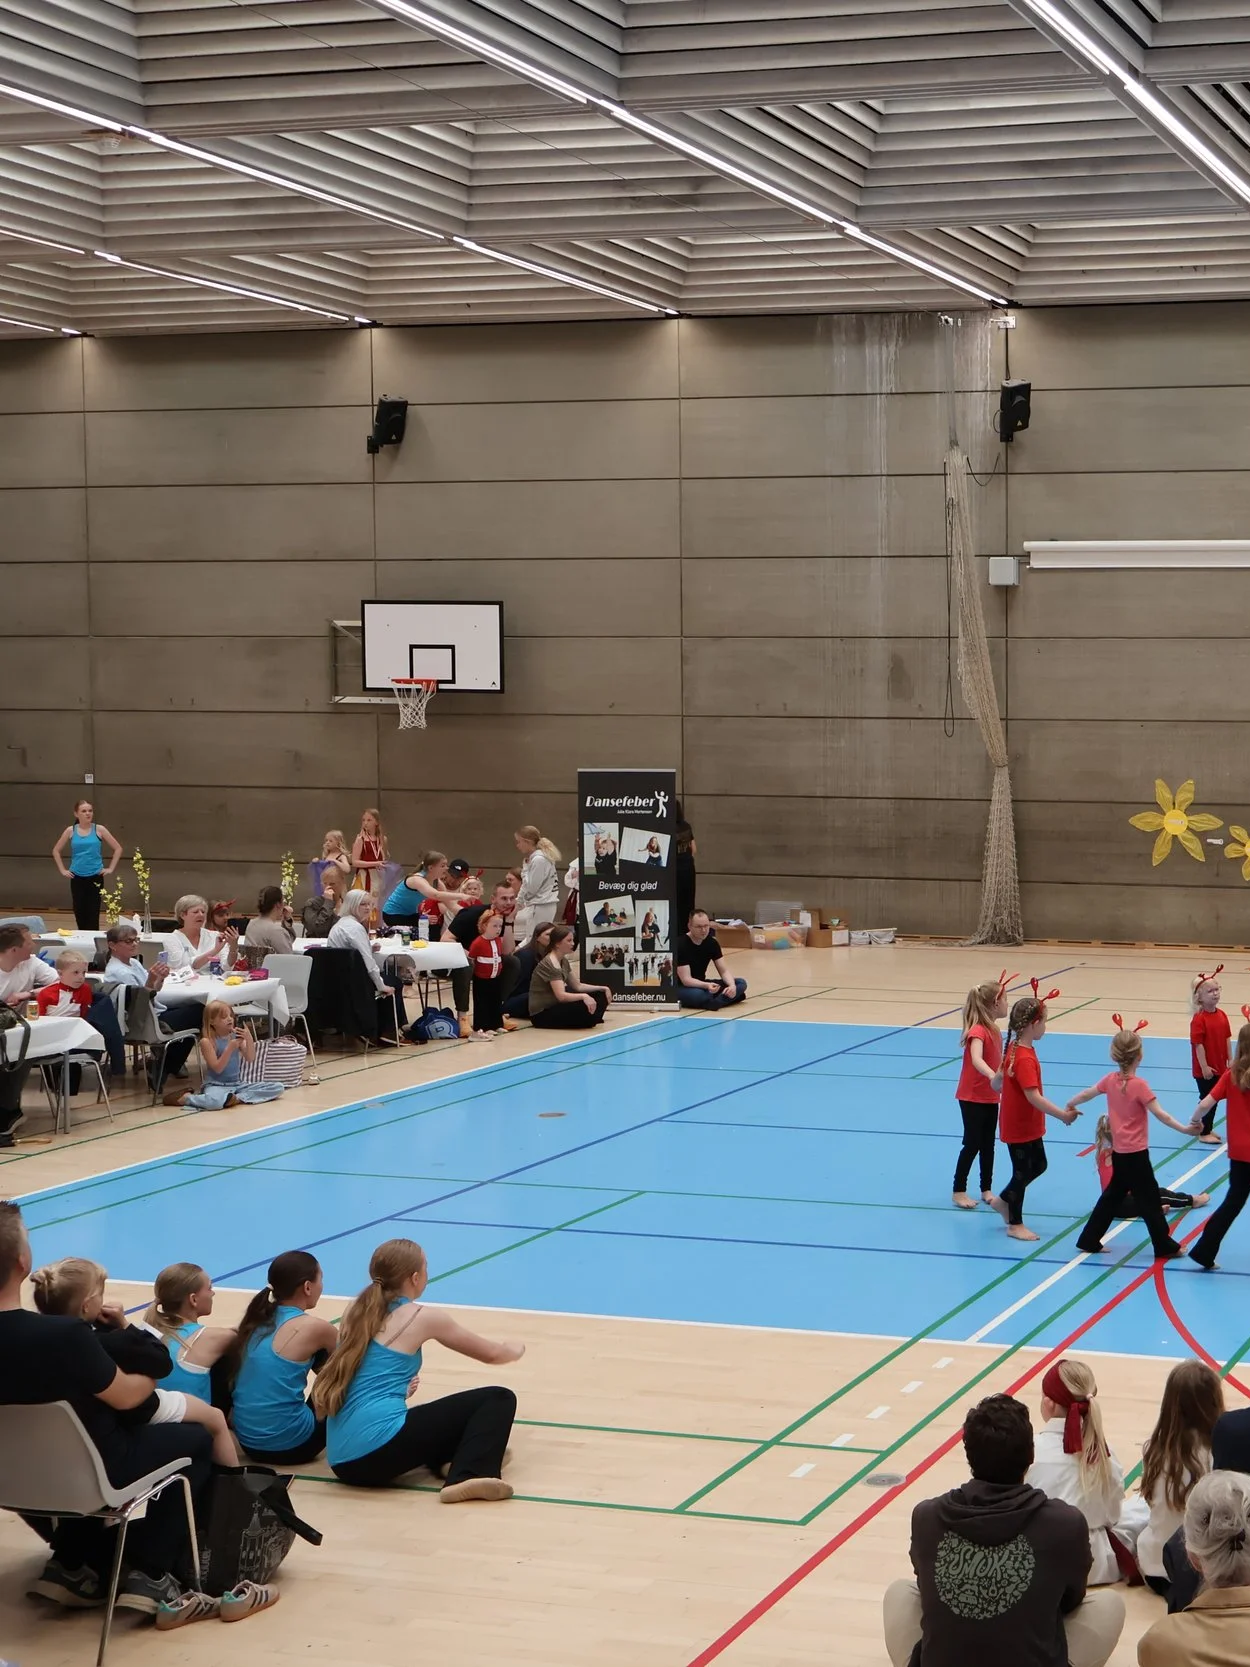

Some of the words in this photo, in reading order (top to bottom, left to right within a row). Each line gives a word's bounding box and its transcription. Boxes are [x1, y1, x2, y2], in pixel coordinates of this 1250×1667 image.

[585, 795, 656, 808] Dansefeber
[598, 881, 626, 892] Bevæg
[627, 881, 640, 892] dig
[640, 881, 658, 892] glad
[612, 992, 666, 1002] dansefeber.nu
[948, 1545, 1010, 1581] SMUK
